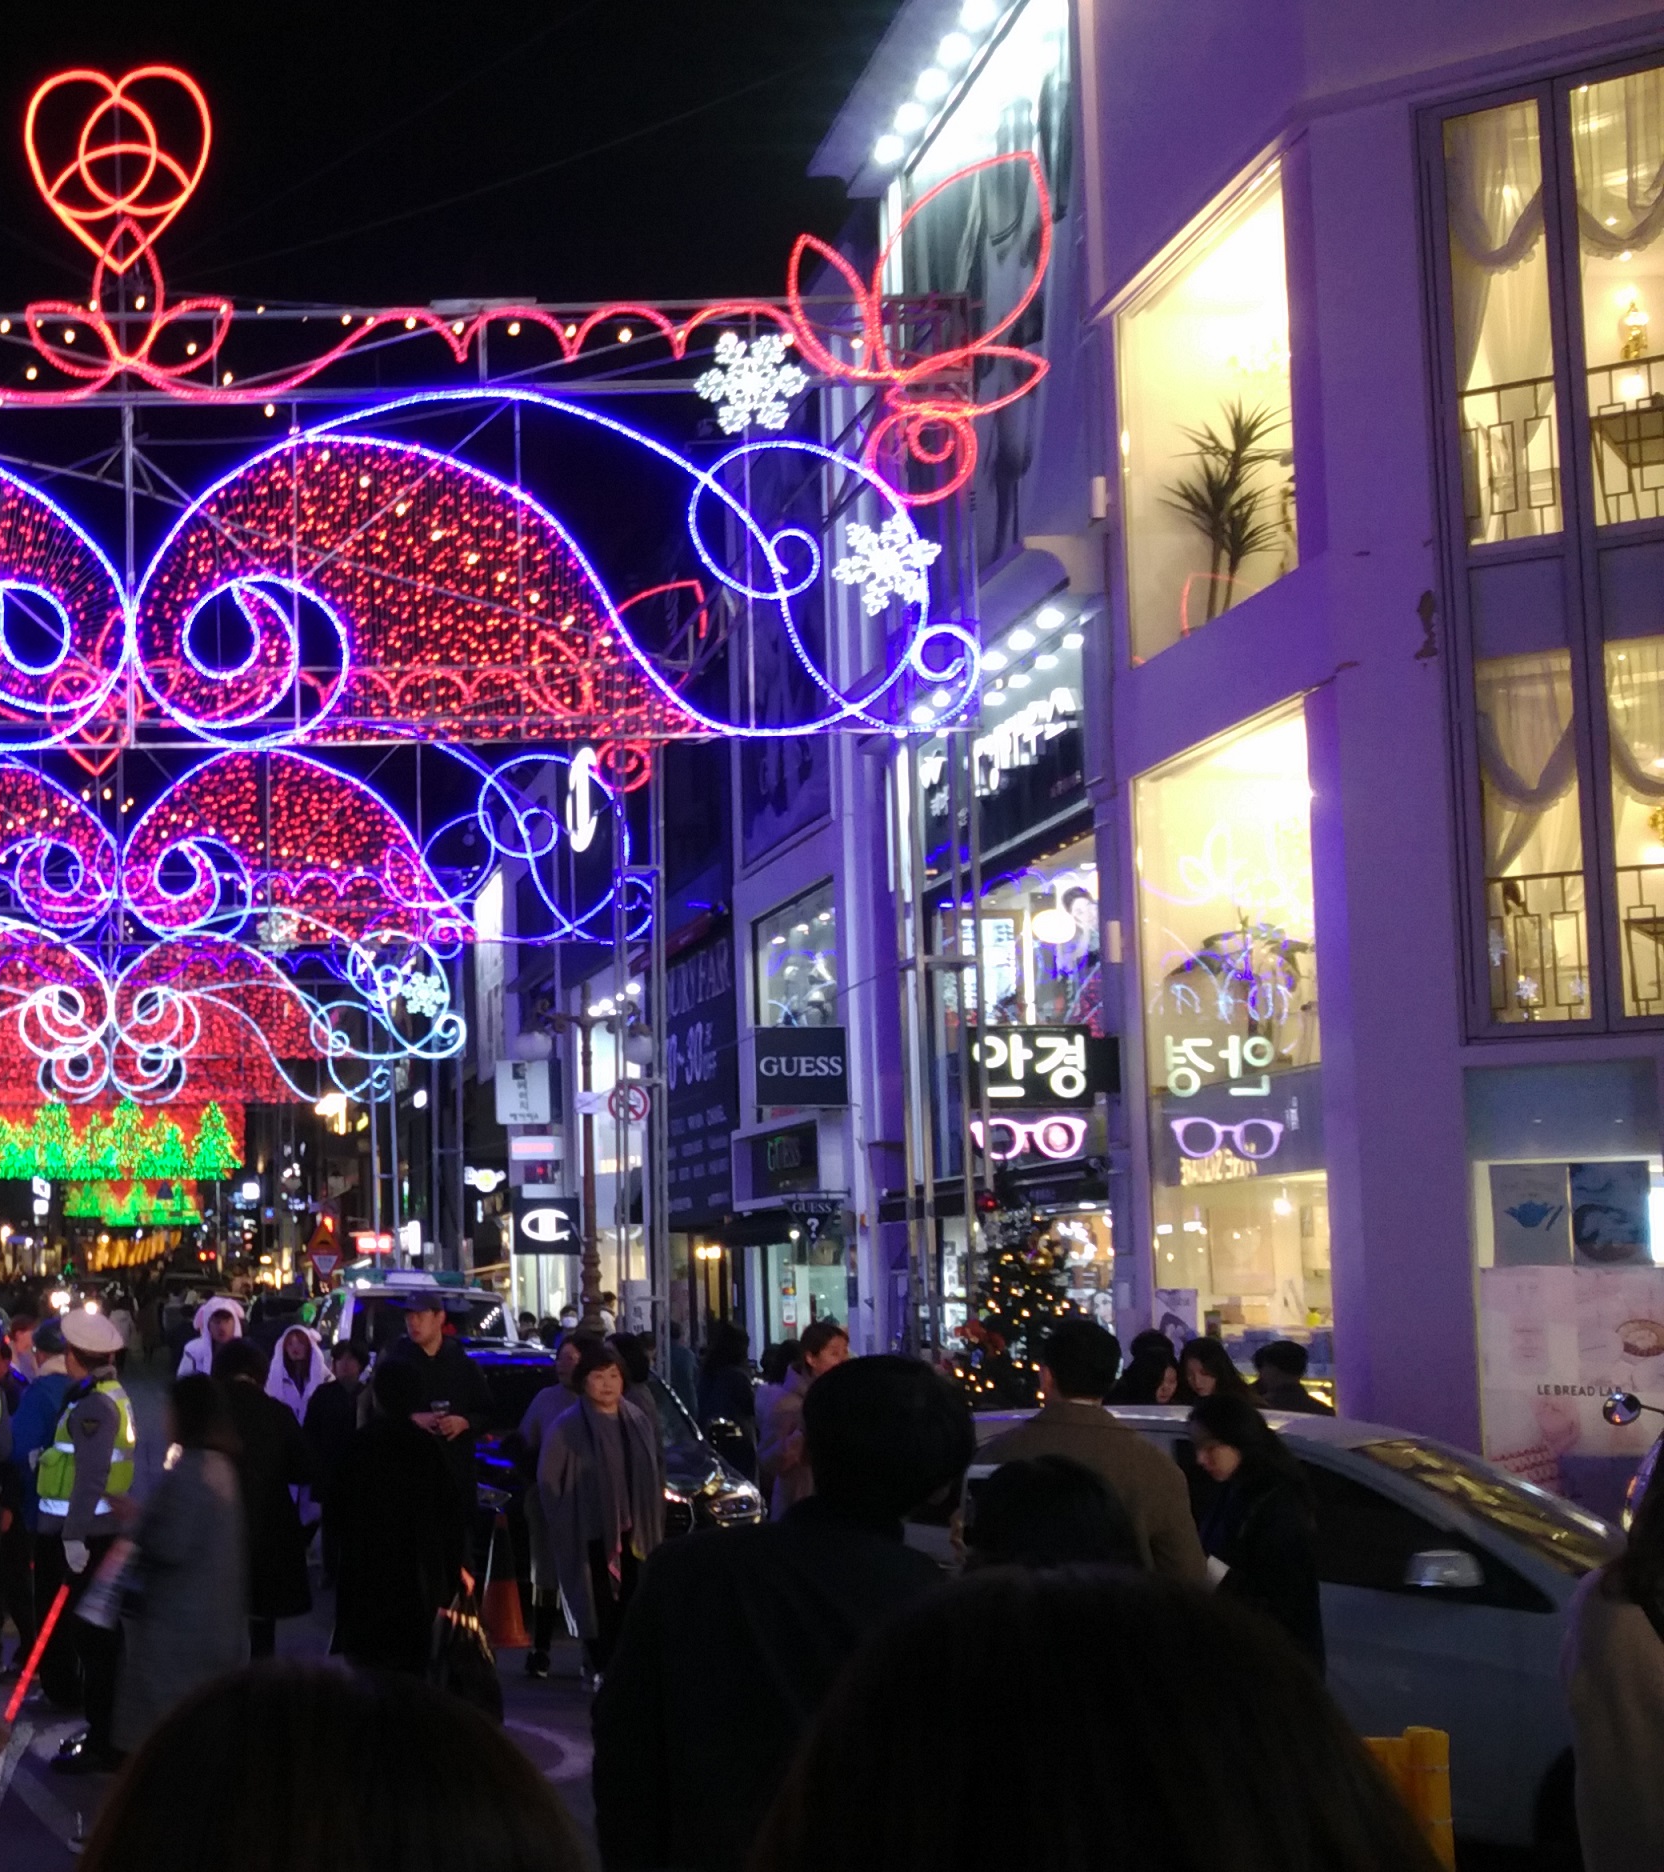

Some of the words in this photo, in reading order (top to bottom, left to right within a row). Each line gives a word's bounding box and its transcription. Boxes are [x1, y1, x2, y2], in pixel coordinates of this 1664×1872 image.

[759, 1056, 843, 1077] GUESS
[972, 1034, 1087, 1099] 안경
[792, 1202, 833, 1215] GUESS
[1537, 1384, 1551, 1397] LE
[1553, 1385, 1595, 1397] BREAD
